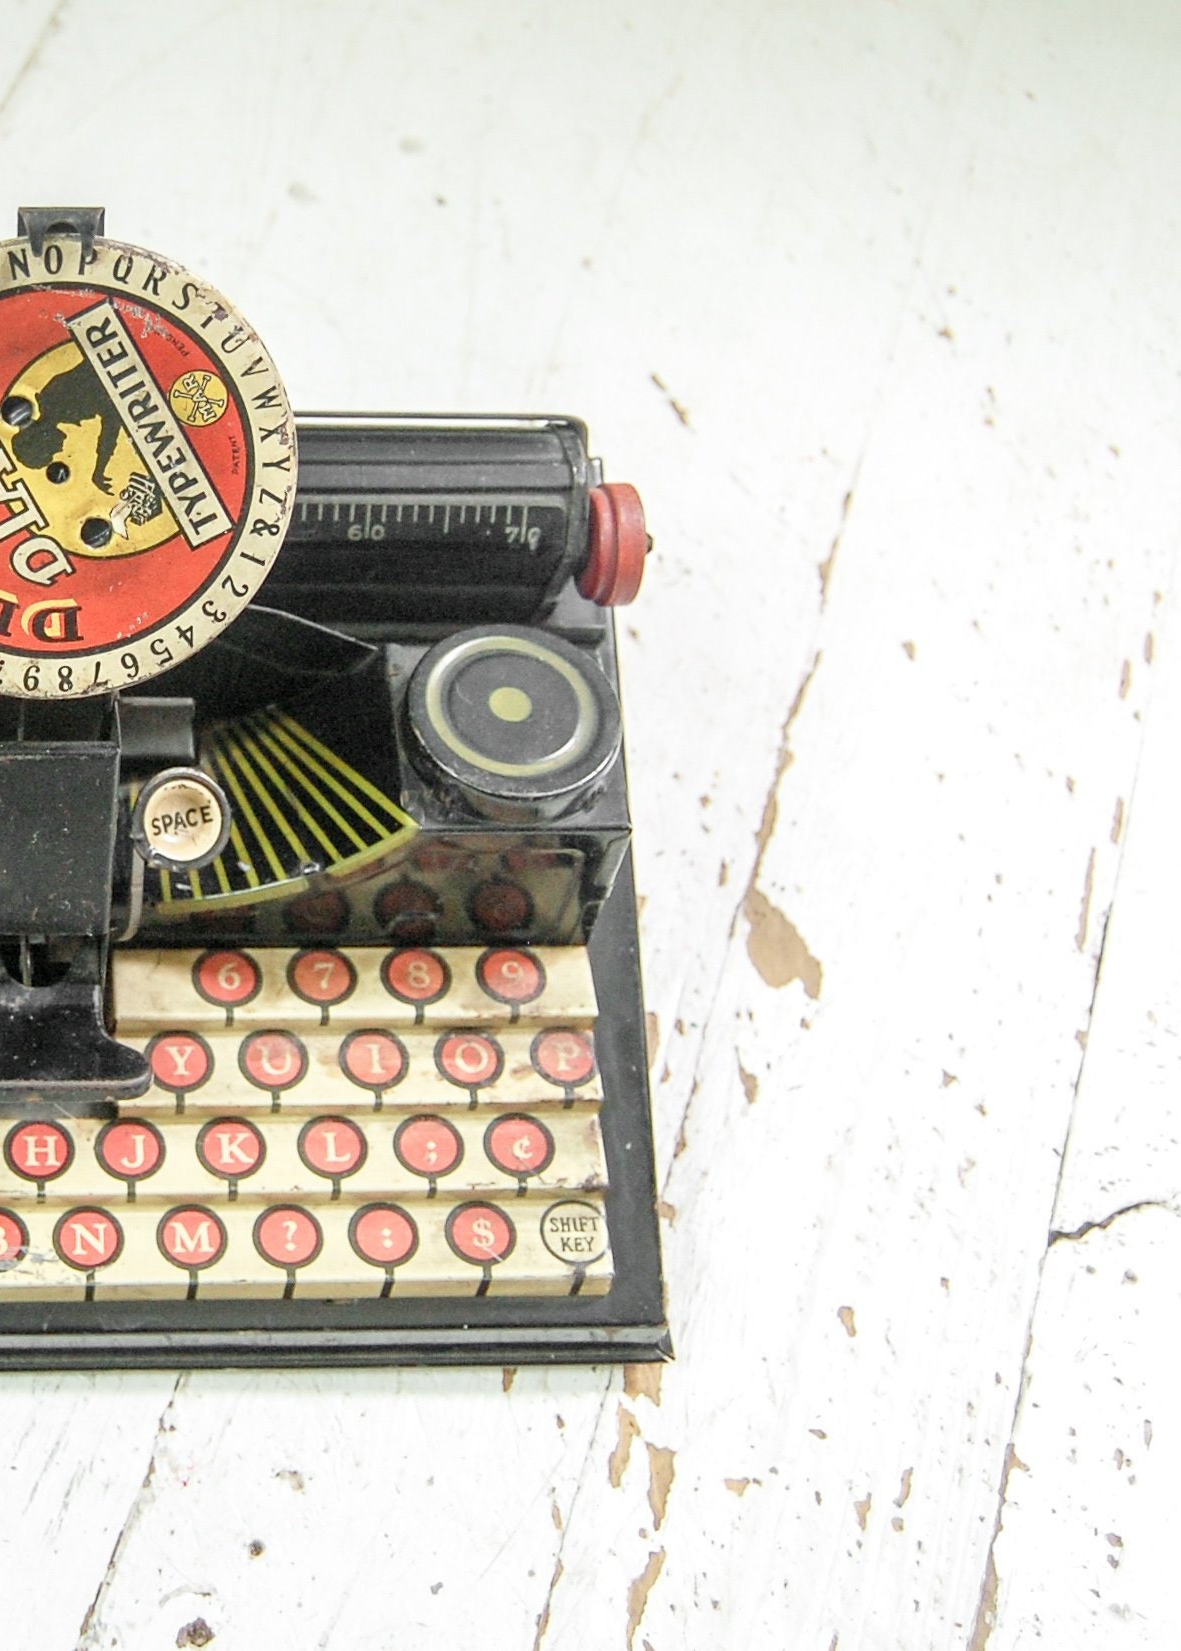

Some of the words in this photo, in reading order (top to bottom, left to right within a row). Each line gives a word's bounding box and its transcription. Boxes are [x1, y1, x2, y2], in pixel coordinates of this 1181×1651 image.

[7, 248, 30, 280] N
[44, 245, 63, 274] O
[112, 254, 134, 284] Q
[142, 264, 167, 296] R
[172, 282, 205, 311] S
[240, 356, 269, 378] V
[251, 385, 283, 411] W
[85, 317, 218, 536] TYPEWRITER
[228, 435, 240, 475] PATENT
[262, 455, 291, 473] Y
[258, 488, 286, 508] Z
[250, 518, 280, 537] &
[221, 575, 249, 598] 2
[201, 600, 227, 623] 3
[175, 625, 195, 648] 4
[120, 652, 140, 678] 6
[150, 638, 174, 667] 5
[23, 665, 41, 692] 9
[57, 665, 73, 692] 8
[93, 661, 109, 687] 7
[151, 805, 213, 836] SPACE
[218, 963, 241, 988] 6
[313, 962, 336, 988] 7
[407, 961, 430, 987] 8
[169, 1045, 199, 1076] Y
[260, 1044, 292, 1076] U
[367, 1044, 388, 1074] I
[455, 1042, 489, 1073] O
[552, 1042, 581, 1071] P
[24, 1136, 61, 1167] H
[120, 1134, 147, 1169] J
[218, 1133, 254, 1164] K
[324, 1132, 351, 1163] L
[72, 1223, 109, 1256] N
[171, 1221, 215, 1254] M
[281, 1220, 298, 1251] ?
[471, 1217, 496, 1250] $
[549, 1216, 600, 1235] SHIFT
[560, 1236, 595, 1253] KEY
